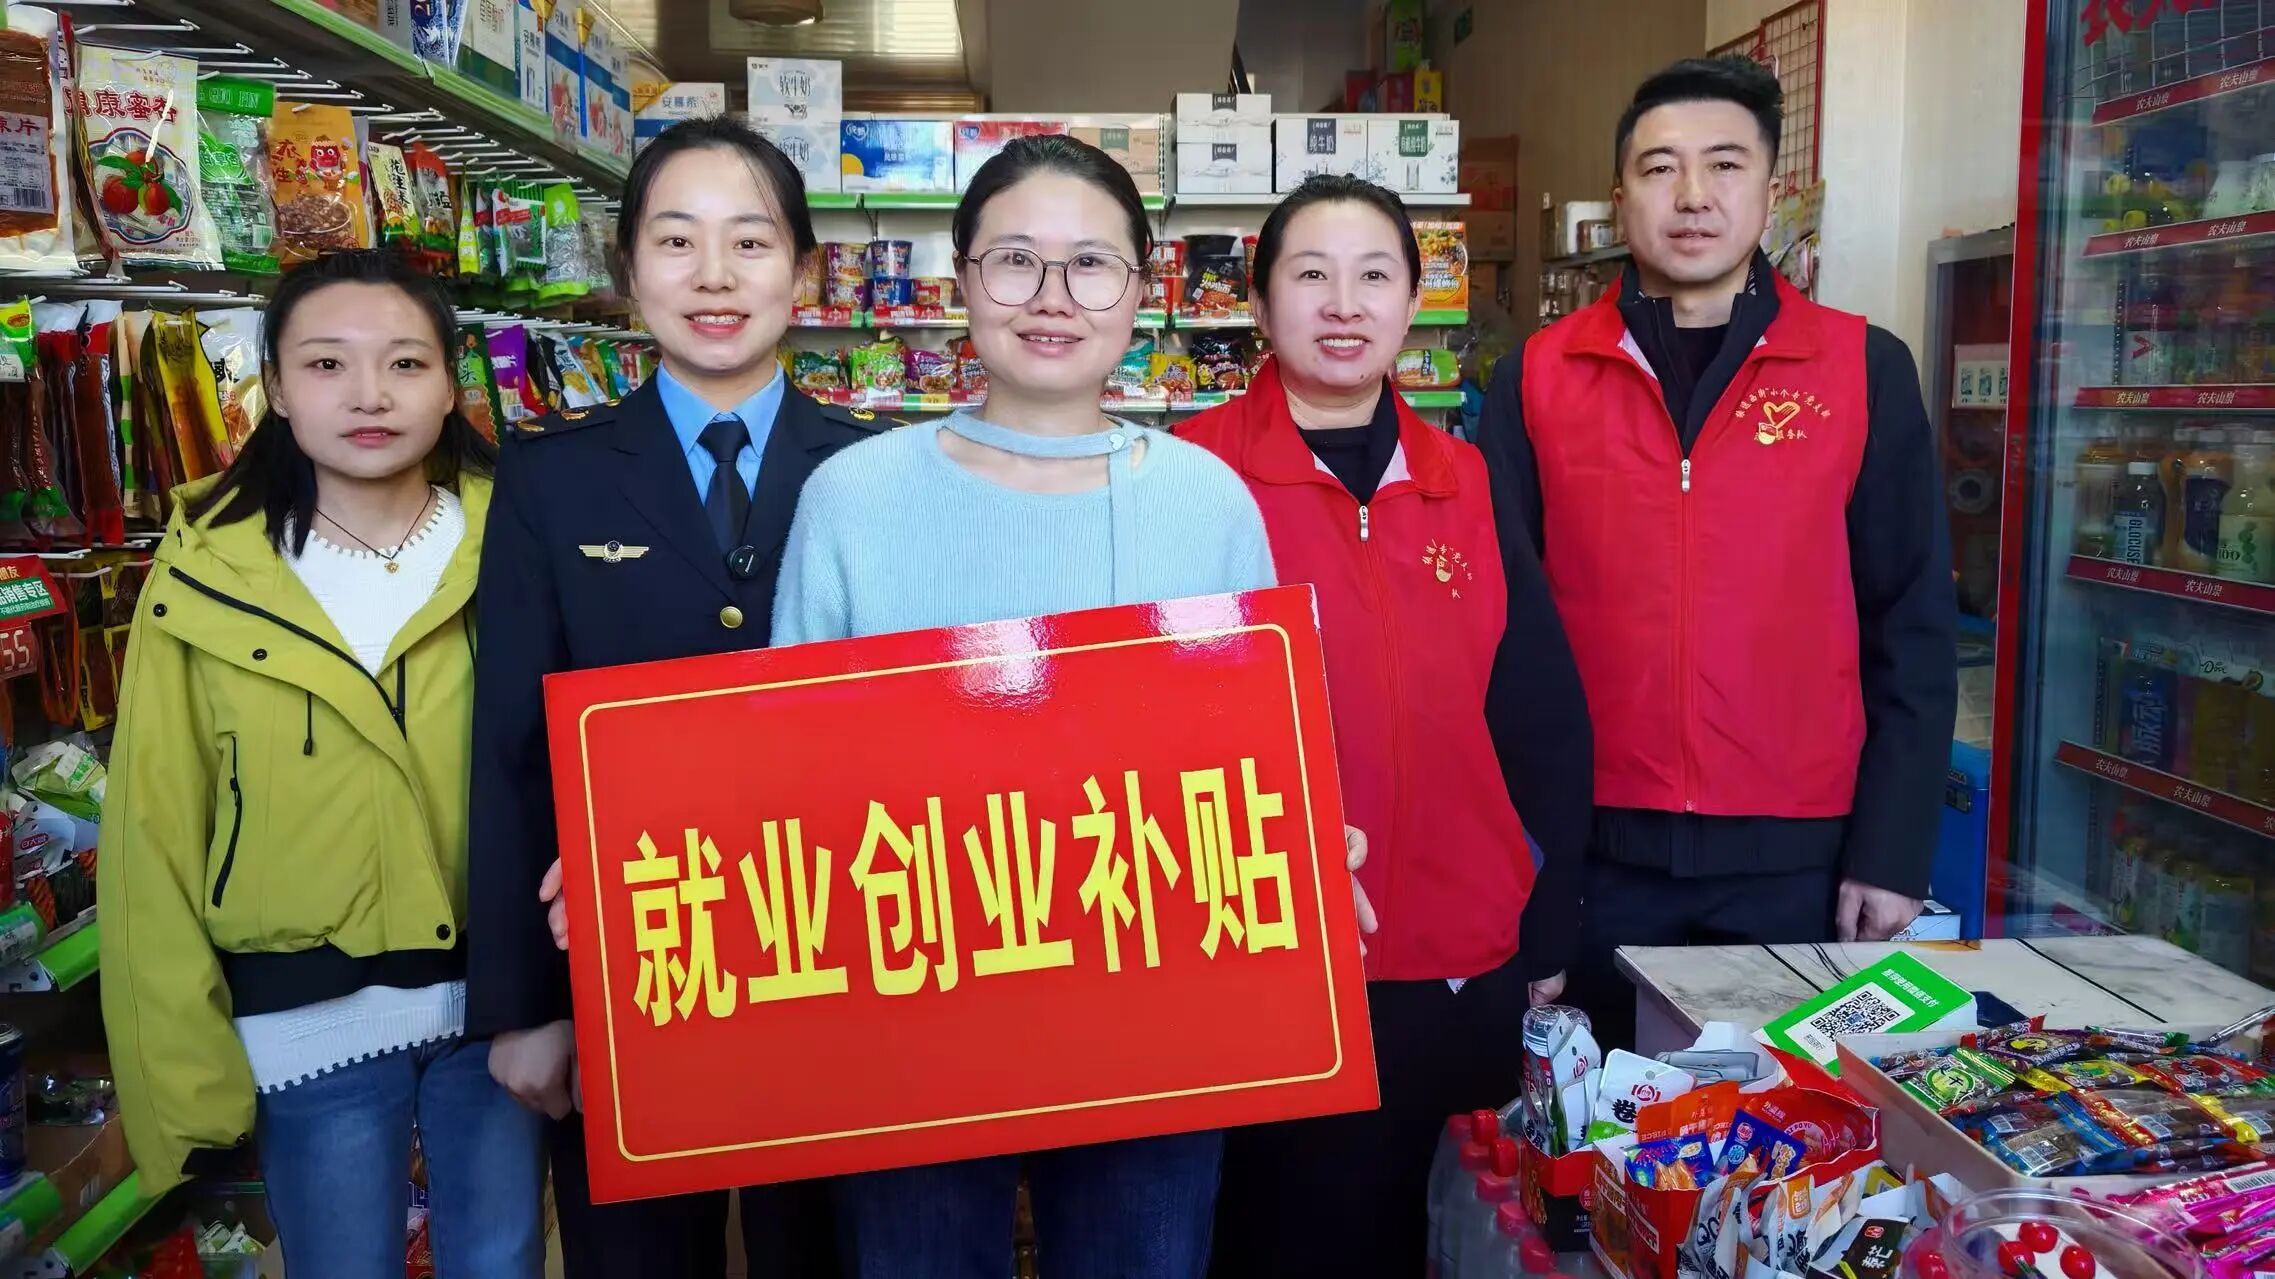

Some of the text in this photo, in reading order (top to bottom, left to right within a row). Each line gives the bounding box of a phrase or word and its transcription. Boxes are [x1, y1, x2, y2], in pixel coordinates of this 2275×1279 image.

[2185, 579, 2223, 598] 农夫山泉
[622, 758, 1299, 1027] 就业创业补贴
